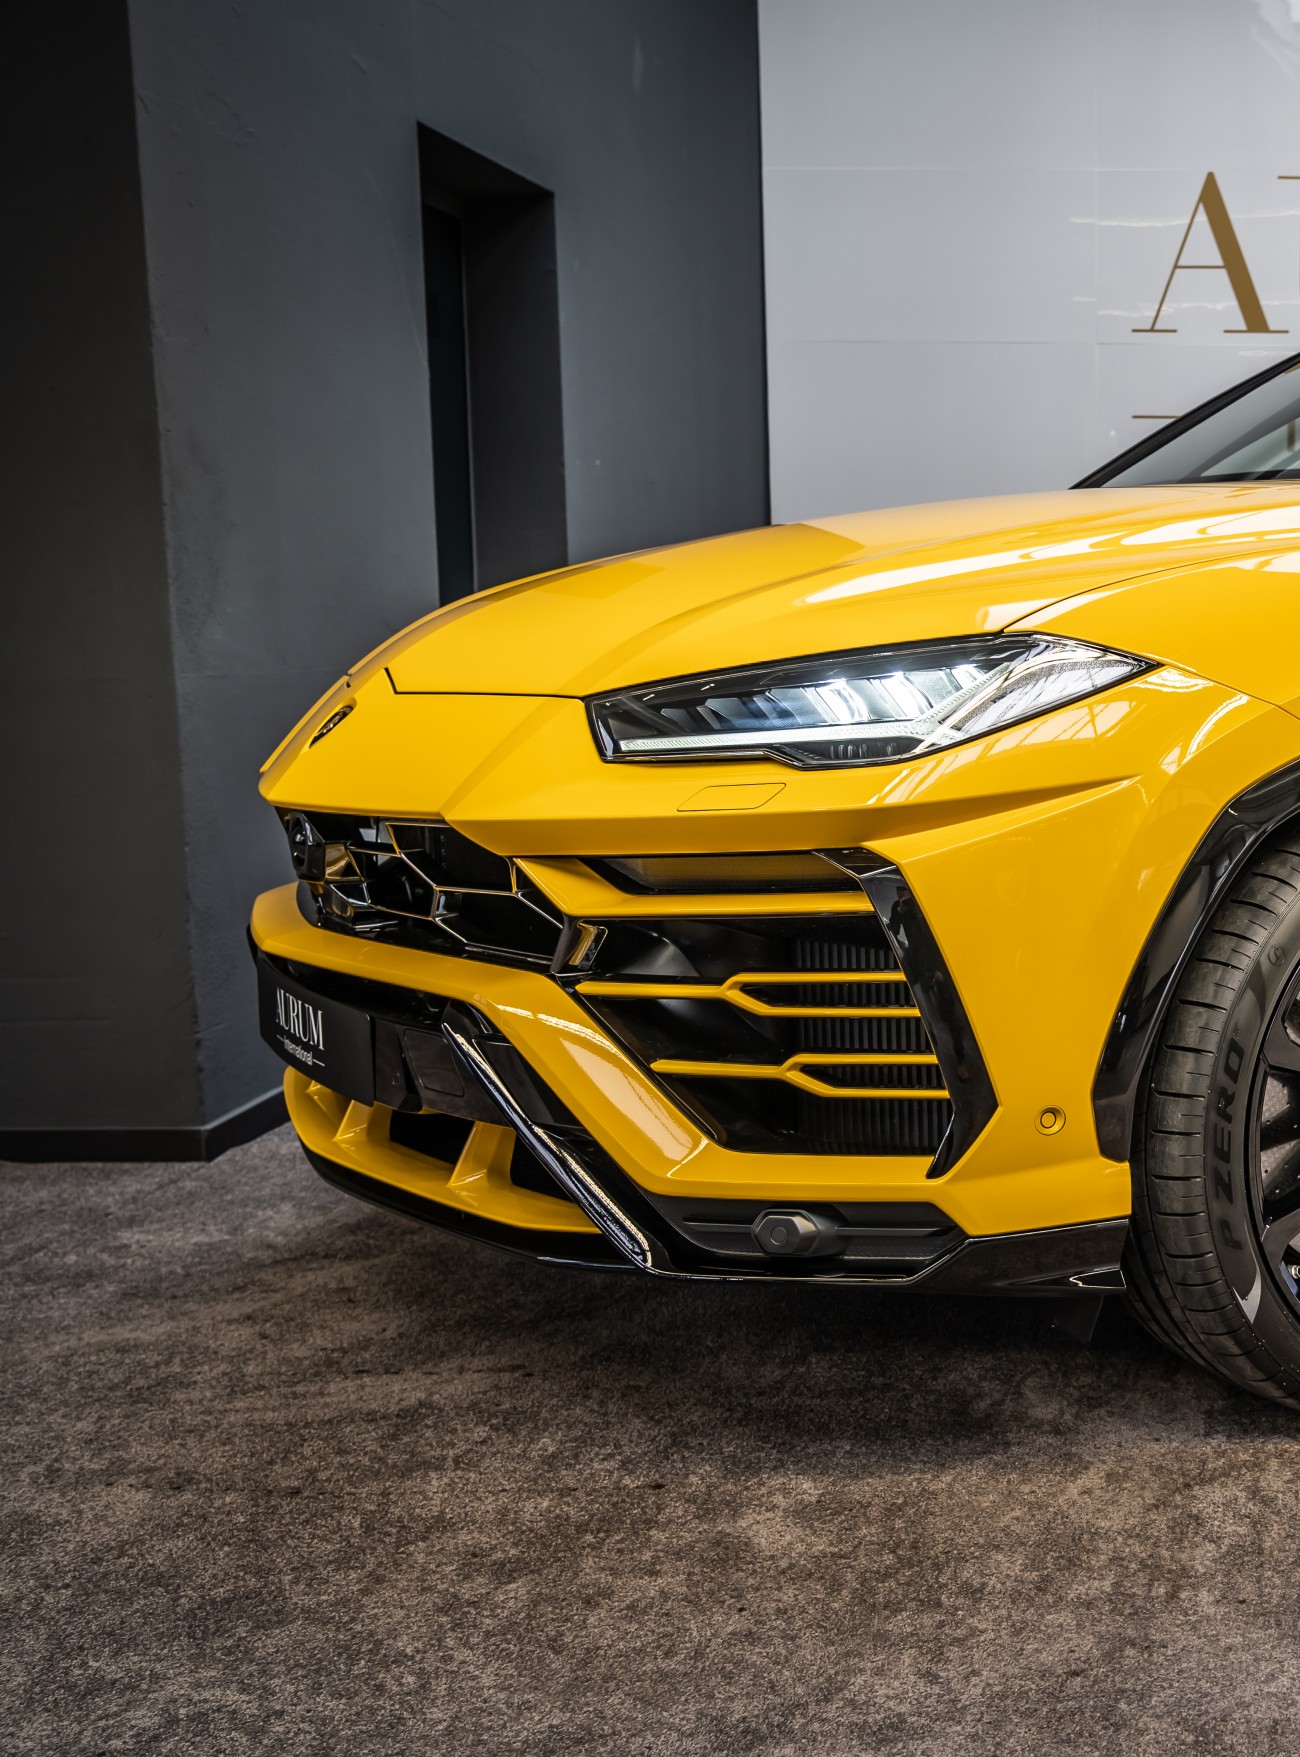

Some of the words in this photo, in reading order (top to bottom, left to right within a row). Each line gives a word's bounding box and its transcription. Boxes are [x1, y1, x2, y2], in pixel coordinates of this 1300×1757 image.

[275, 987, 325, 1051] AURUM
[1213, 1037, 1245, 1205] ZERO
[1219, 1219, 1243, 1250] P
